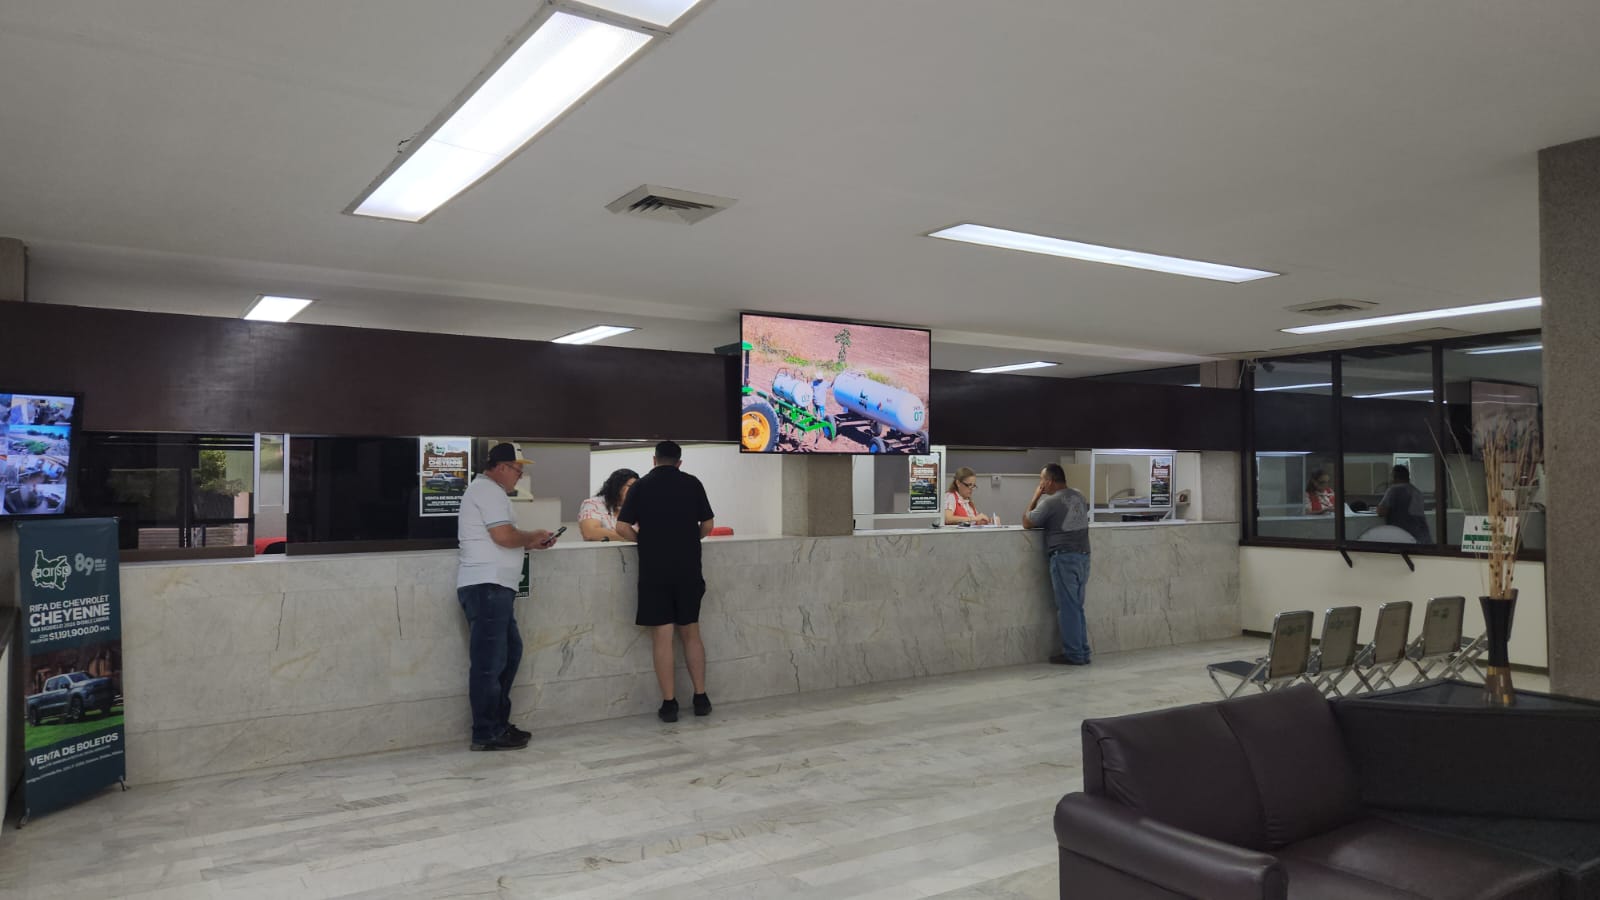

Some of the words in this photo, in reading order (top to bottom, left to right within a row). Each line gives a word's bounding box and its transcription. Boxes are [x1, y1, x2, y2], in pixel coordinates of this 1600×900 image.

[75, 553, 94, 576] 89
[29, 603, 49, 612] RIFA
[49, 601, 62, 610] DE
[62, 594, 110, 608] CHEVROLET
[29, 603, 110, 627] CHEYENNE
[29, 749, 61, 767] VENTA
[61, 744, 76, 756] DE
[76, 732, 119, 752] BOLETOS
